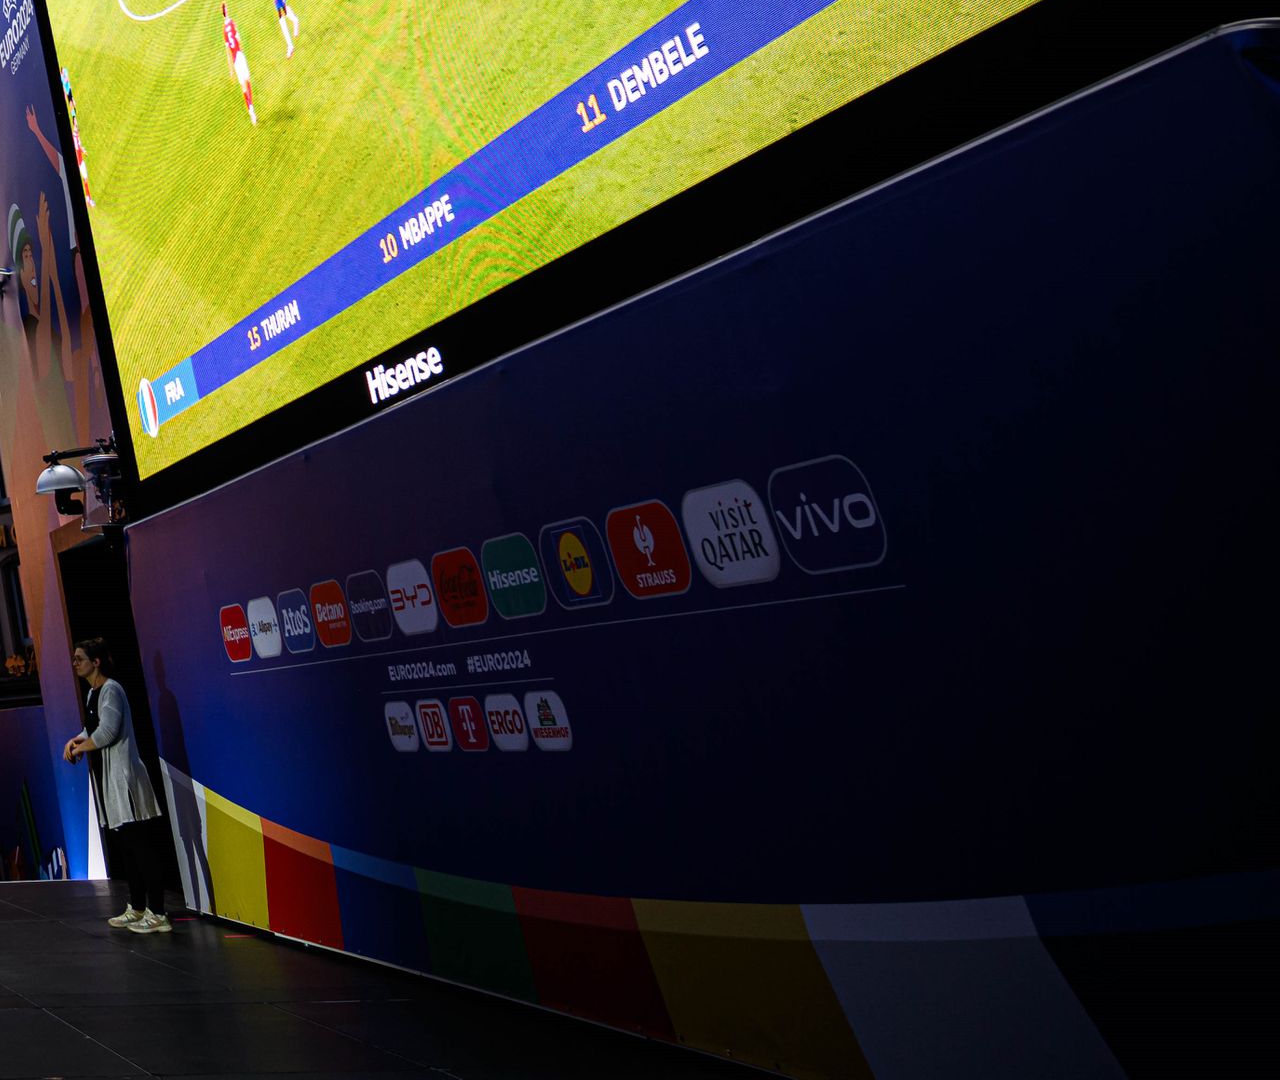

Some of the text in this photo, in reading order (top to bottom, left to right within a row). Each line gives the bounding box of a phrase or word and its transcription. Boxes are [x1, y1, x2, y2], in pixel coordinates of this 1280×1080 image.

[576, 21, 710, 133] 11 DEMBELE
[379, 193, 455, 263] 10 MBAPPE
[247, 299, 301, 351] 15 THURAM
[365, 346, 444, 404] Hisense
[163, 377, 185, 406] FRA
[708, 497, 758, 531] visit
[776, 491, 876, 540] vivo
[700, 528, 769, 571] QATAR
[487, 566, 540, 591] Hisense
[635, 568, 677, 588] STRAUSS
[349, 597, 387, 615] Booking.com
[390, 584, 432, 611] BYD
[281, 605, 312, 638] Atos
[315, 602, 345, 623] Betano
[223, 625, 249, 644] AliExpress
[387, 649, 532, 681] EURO2024.com #EURO2024
[422, 711, 444, 739] DB
[487, 709, 524, 735] ERGO
[531, 726, 570, 739] WIESENHOF
